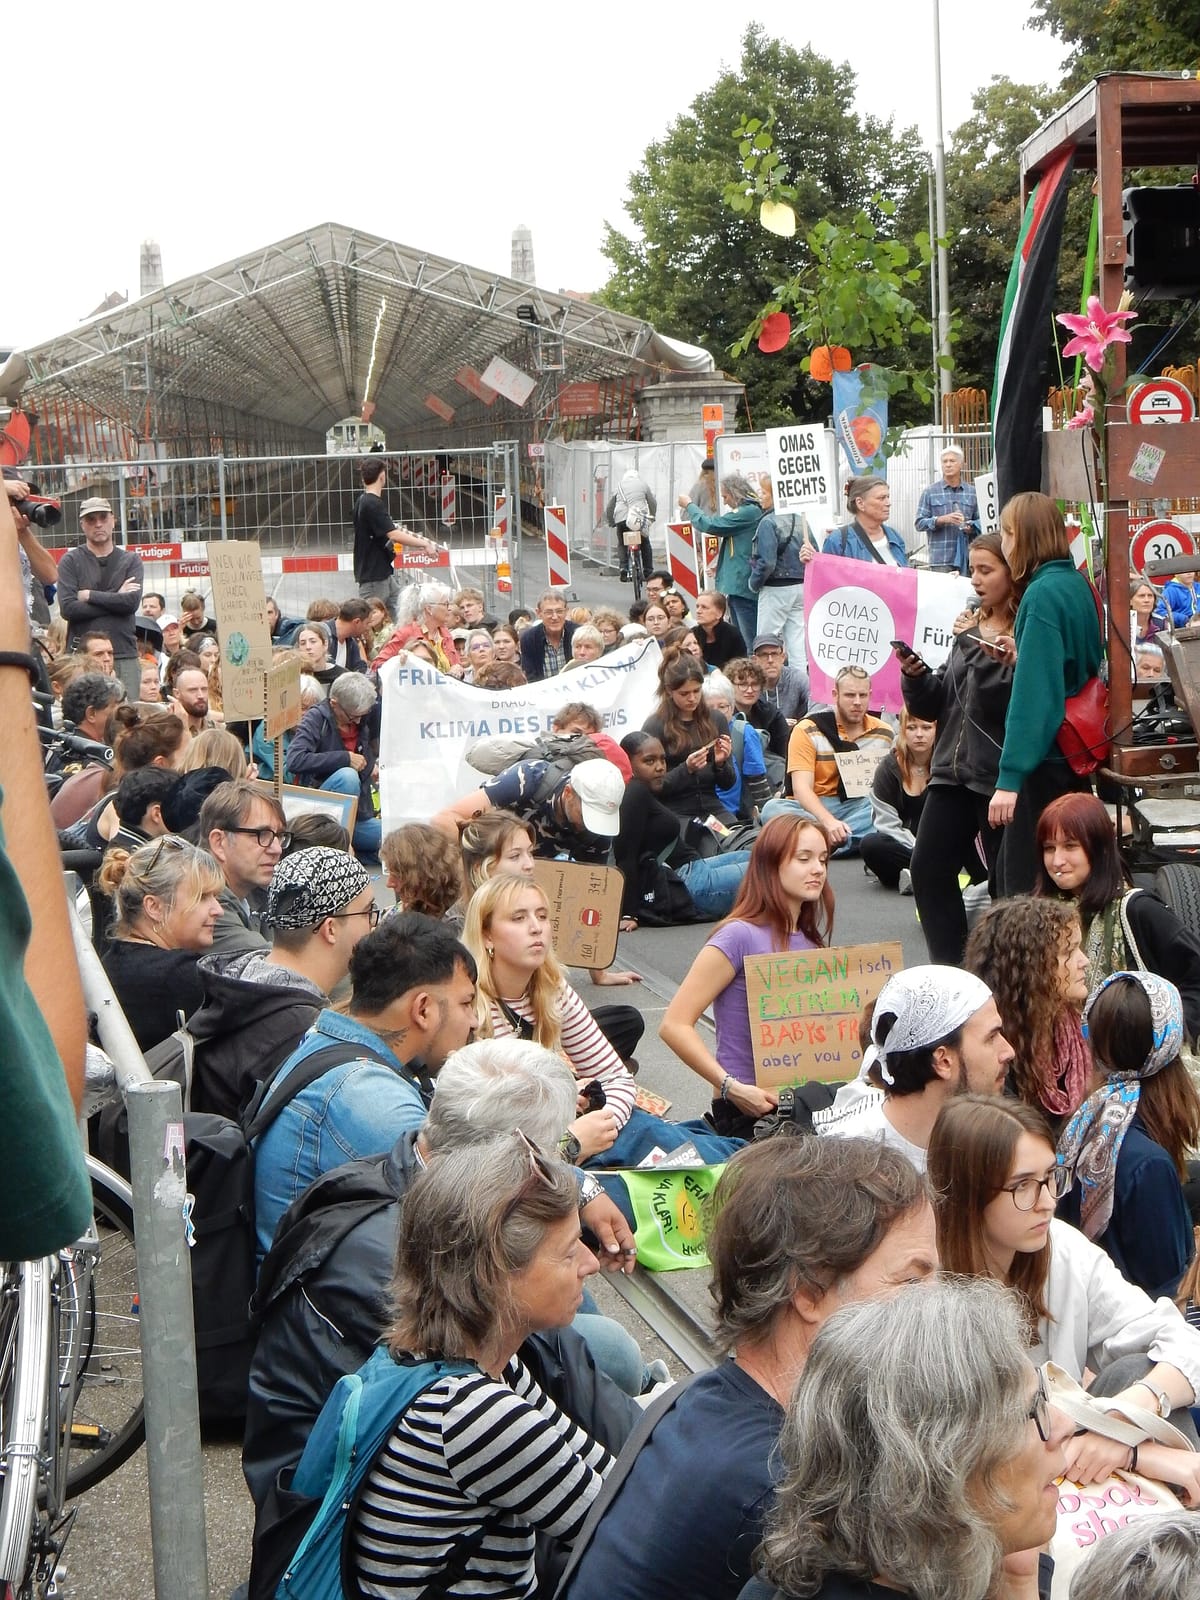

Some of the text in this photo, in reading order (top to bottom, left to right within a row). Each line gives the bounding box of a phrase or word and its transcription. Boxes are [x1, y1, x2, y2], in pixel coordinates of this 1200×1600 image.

[779, 432, 815, 454] OMAS
[778, 454, 821, 476] GEGEN
[777, 476, 827, 499] RECHTS
[134, 546, 173, 559] Frutiger
[1152, 543, 1176, 560] 30
[828, 601, 879, 622] OMAS
[822, 622, 879, 644] GEGEN
[922, 626, 953, 648] Für
[817, 642, 879, 666] RECHTS
[398, 668, 447, 686] FRIE
[576, 655, 637, 691] KLIMA
[419, 720, 491, 740] KLIMA
[499, 716, 540, 735] DES
[580, 943, 593, 960] 160
[756, 952, 892, 991] VEGAN isch
[759, 987, 861, 1019] EXTREM
[762, 1051, 802, 1067] aber
[814, 1051, 841, 1063] vou
